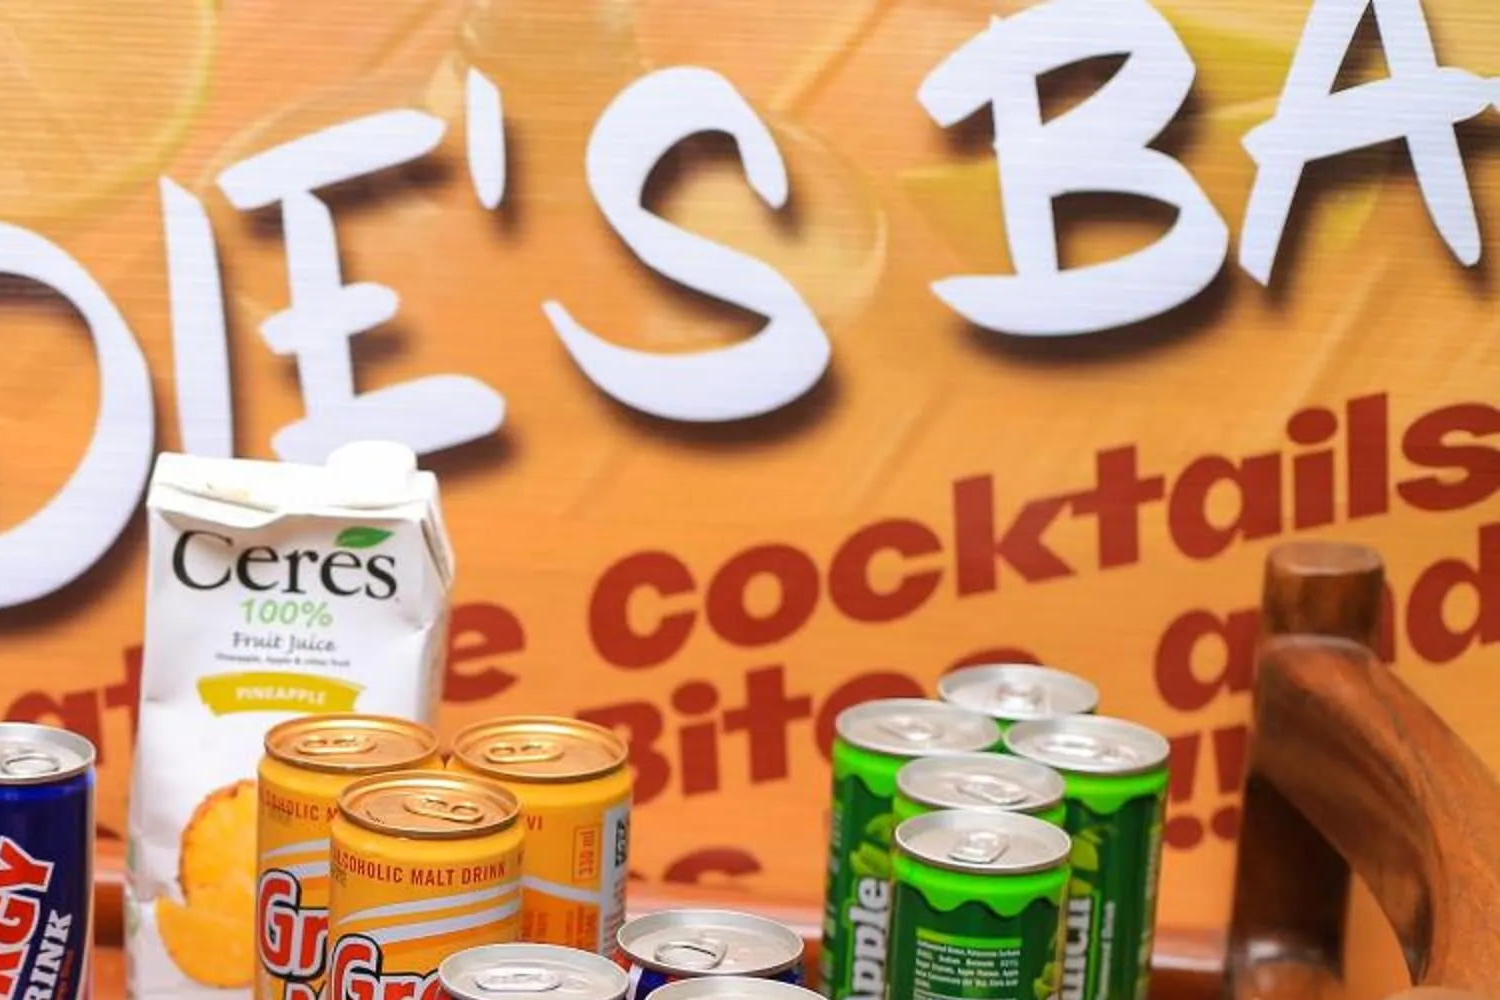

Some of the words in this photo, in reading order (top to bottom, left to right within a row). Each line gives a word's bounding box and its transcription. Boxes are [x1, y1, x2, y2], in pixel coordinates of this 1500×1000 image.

[587, 392, 1500, 670] cocktails
[172, 528, 398, 601] Ceres
[238, 598, 333, 628] 100%
[1153, 520, 1500, 713] ad
[232, 631, 282, 649] Fruit
[286, 634, 337, 654] Juice
[235, 686, 327, 706] PINEAPPLE
[410, 867, 455, 886] MALT
[460, 862, 506, 885] DRINK
